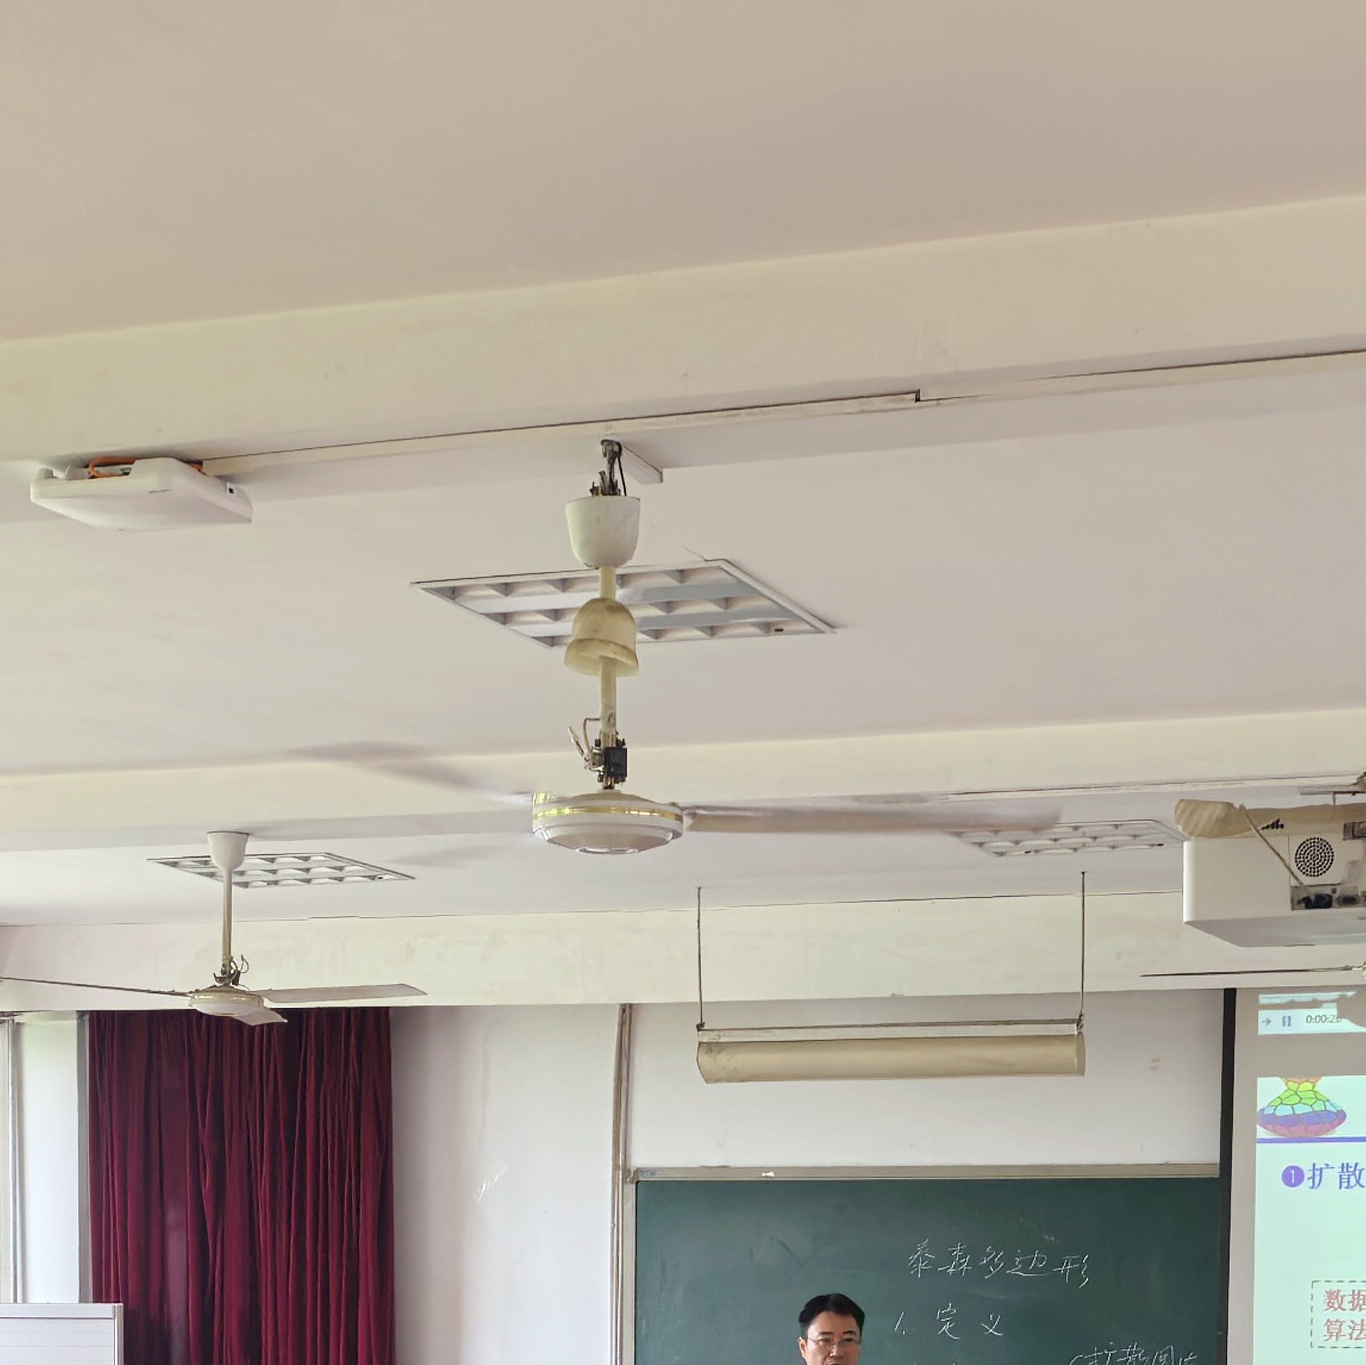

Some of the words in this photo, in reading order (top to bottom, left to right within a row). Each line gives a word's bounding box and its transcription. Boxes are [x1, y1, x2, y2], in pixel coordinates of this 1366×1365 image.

[907, 1238, 1090, 1289] 泰森多边形
